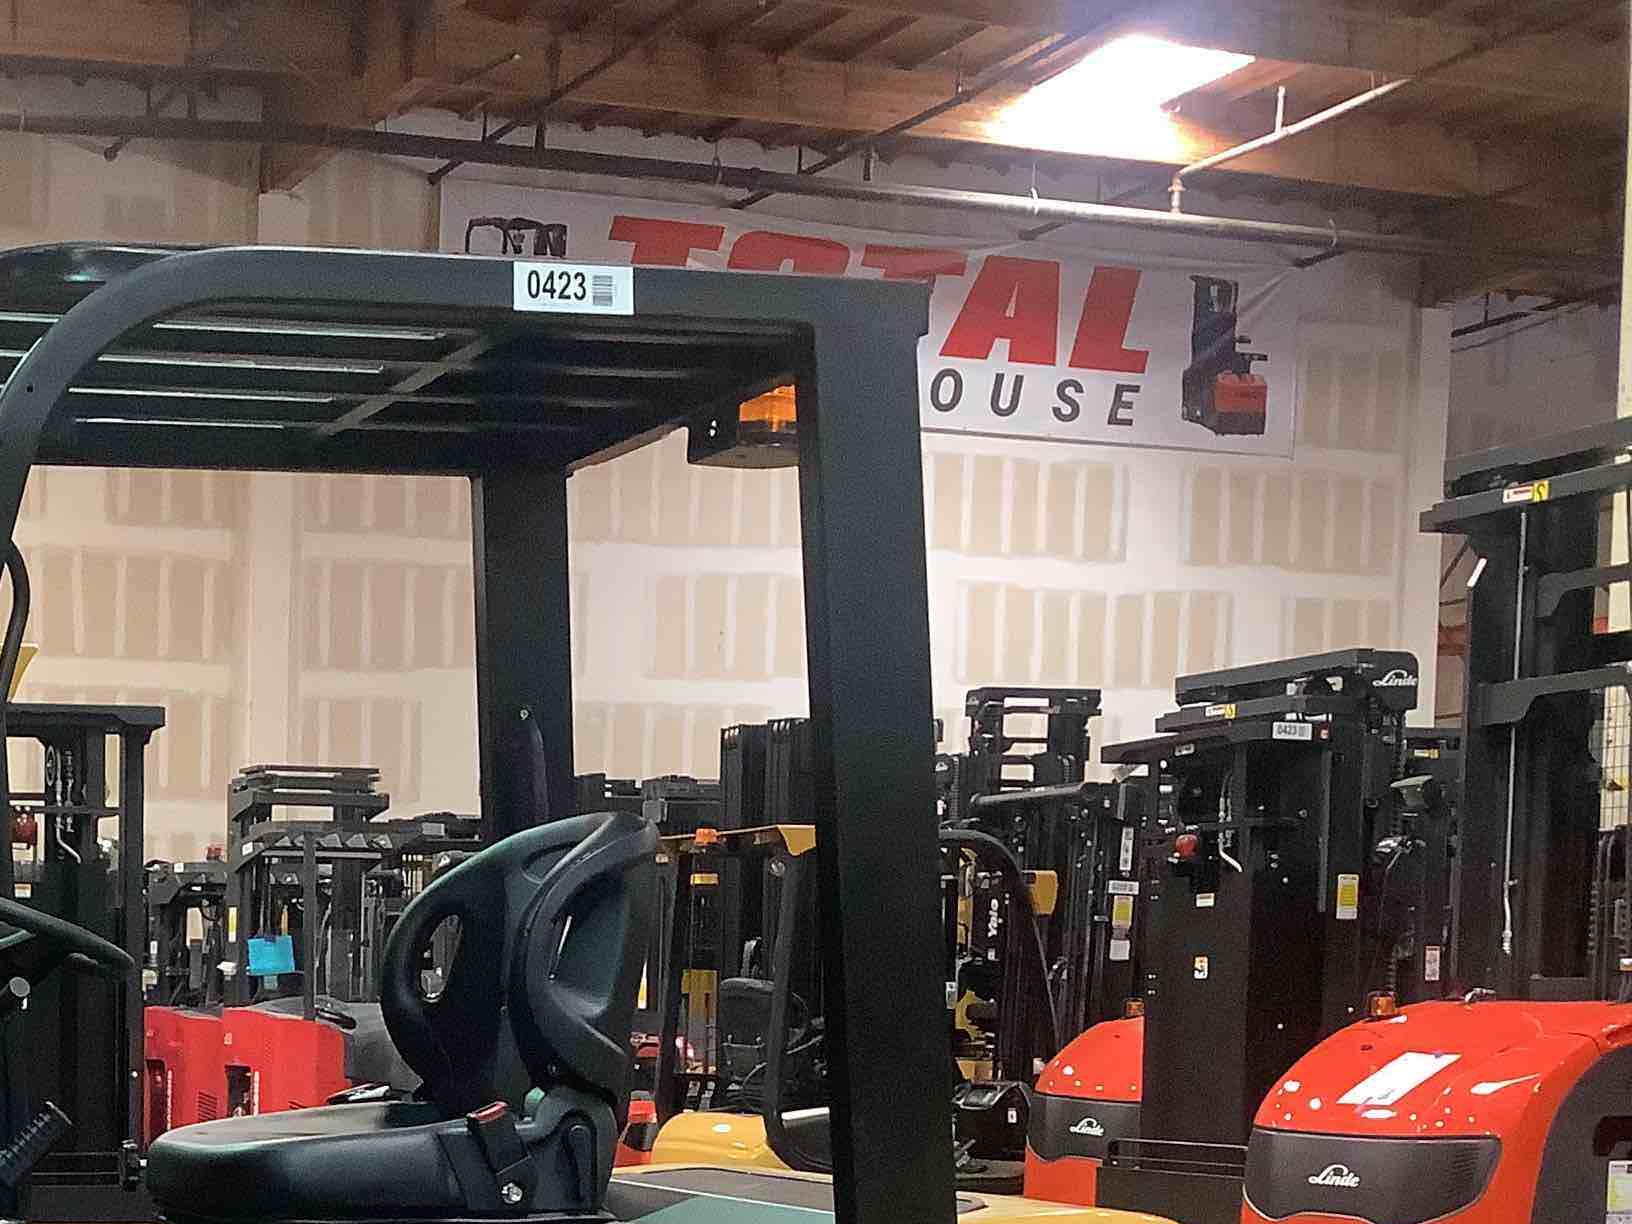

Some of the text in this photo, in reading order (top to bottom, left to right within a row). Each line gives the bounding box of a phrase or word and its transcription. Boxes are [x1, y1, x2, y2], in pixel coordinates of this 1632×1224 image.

[527, 269, 587, 301] 0423
[1069, 1117, 1105, 1137] Linde
[1308, 1164, 1360, 1188] Linde
